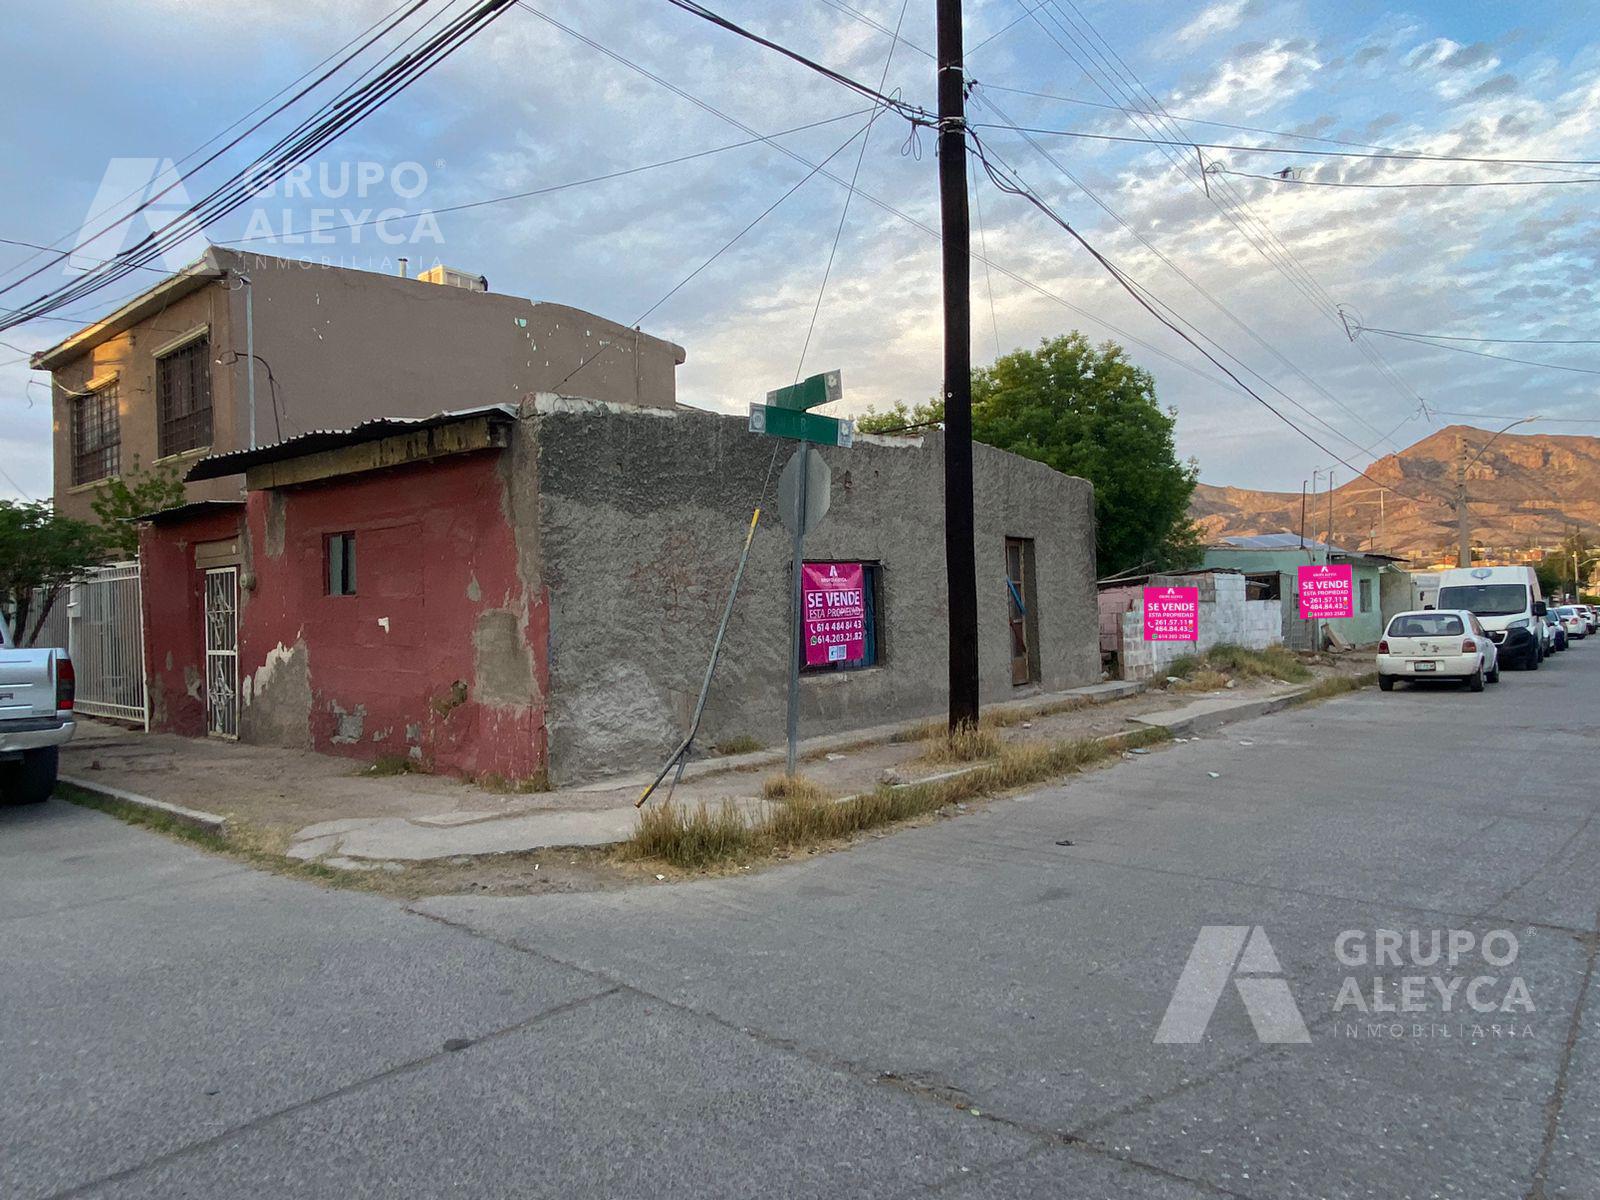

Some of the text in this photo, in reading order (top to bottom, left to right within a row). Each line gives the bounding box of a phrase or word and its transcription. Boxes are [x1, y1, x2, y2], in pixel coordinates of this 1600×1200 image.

[1302, 580, 1349, 590] SE VENDE
[808, 591, 860, 608] SE VENDE
[1147, 602, 1195, 611] SE VENDE
[810, 608, 826, 618] ESTA
